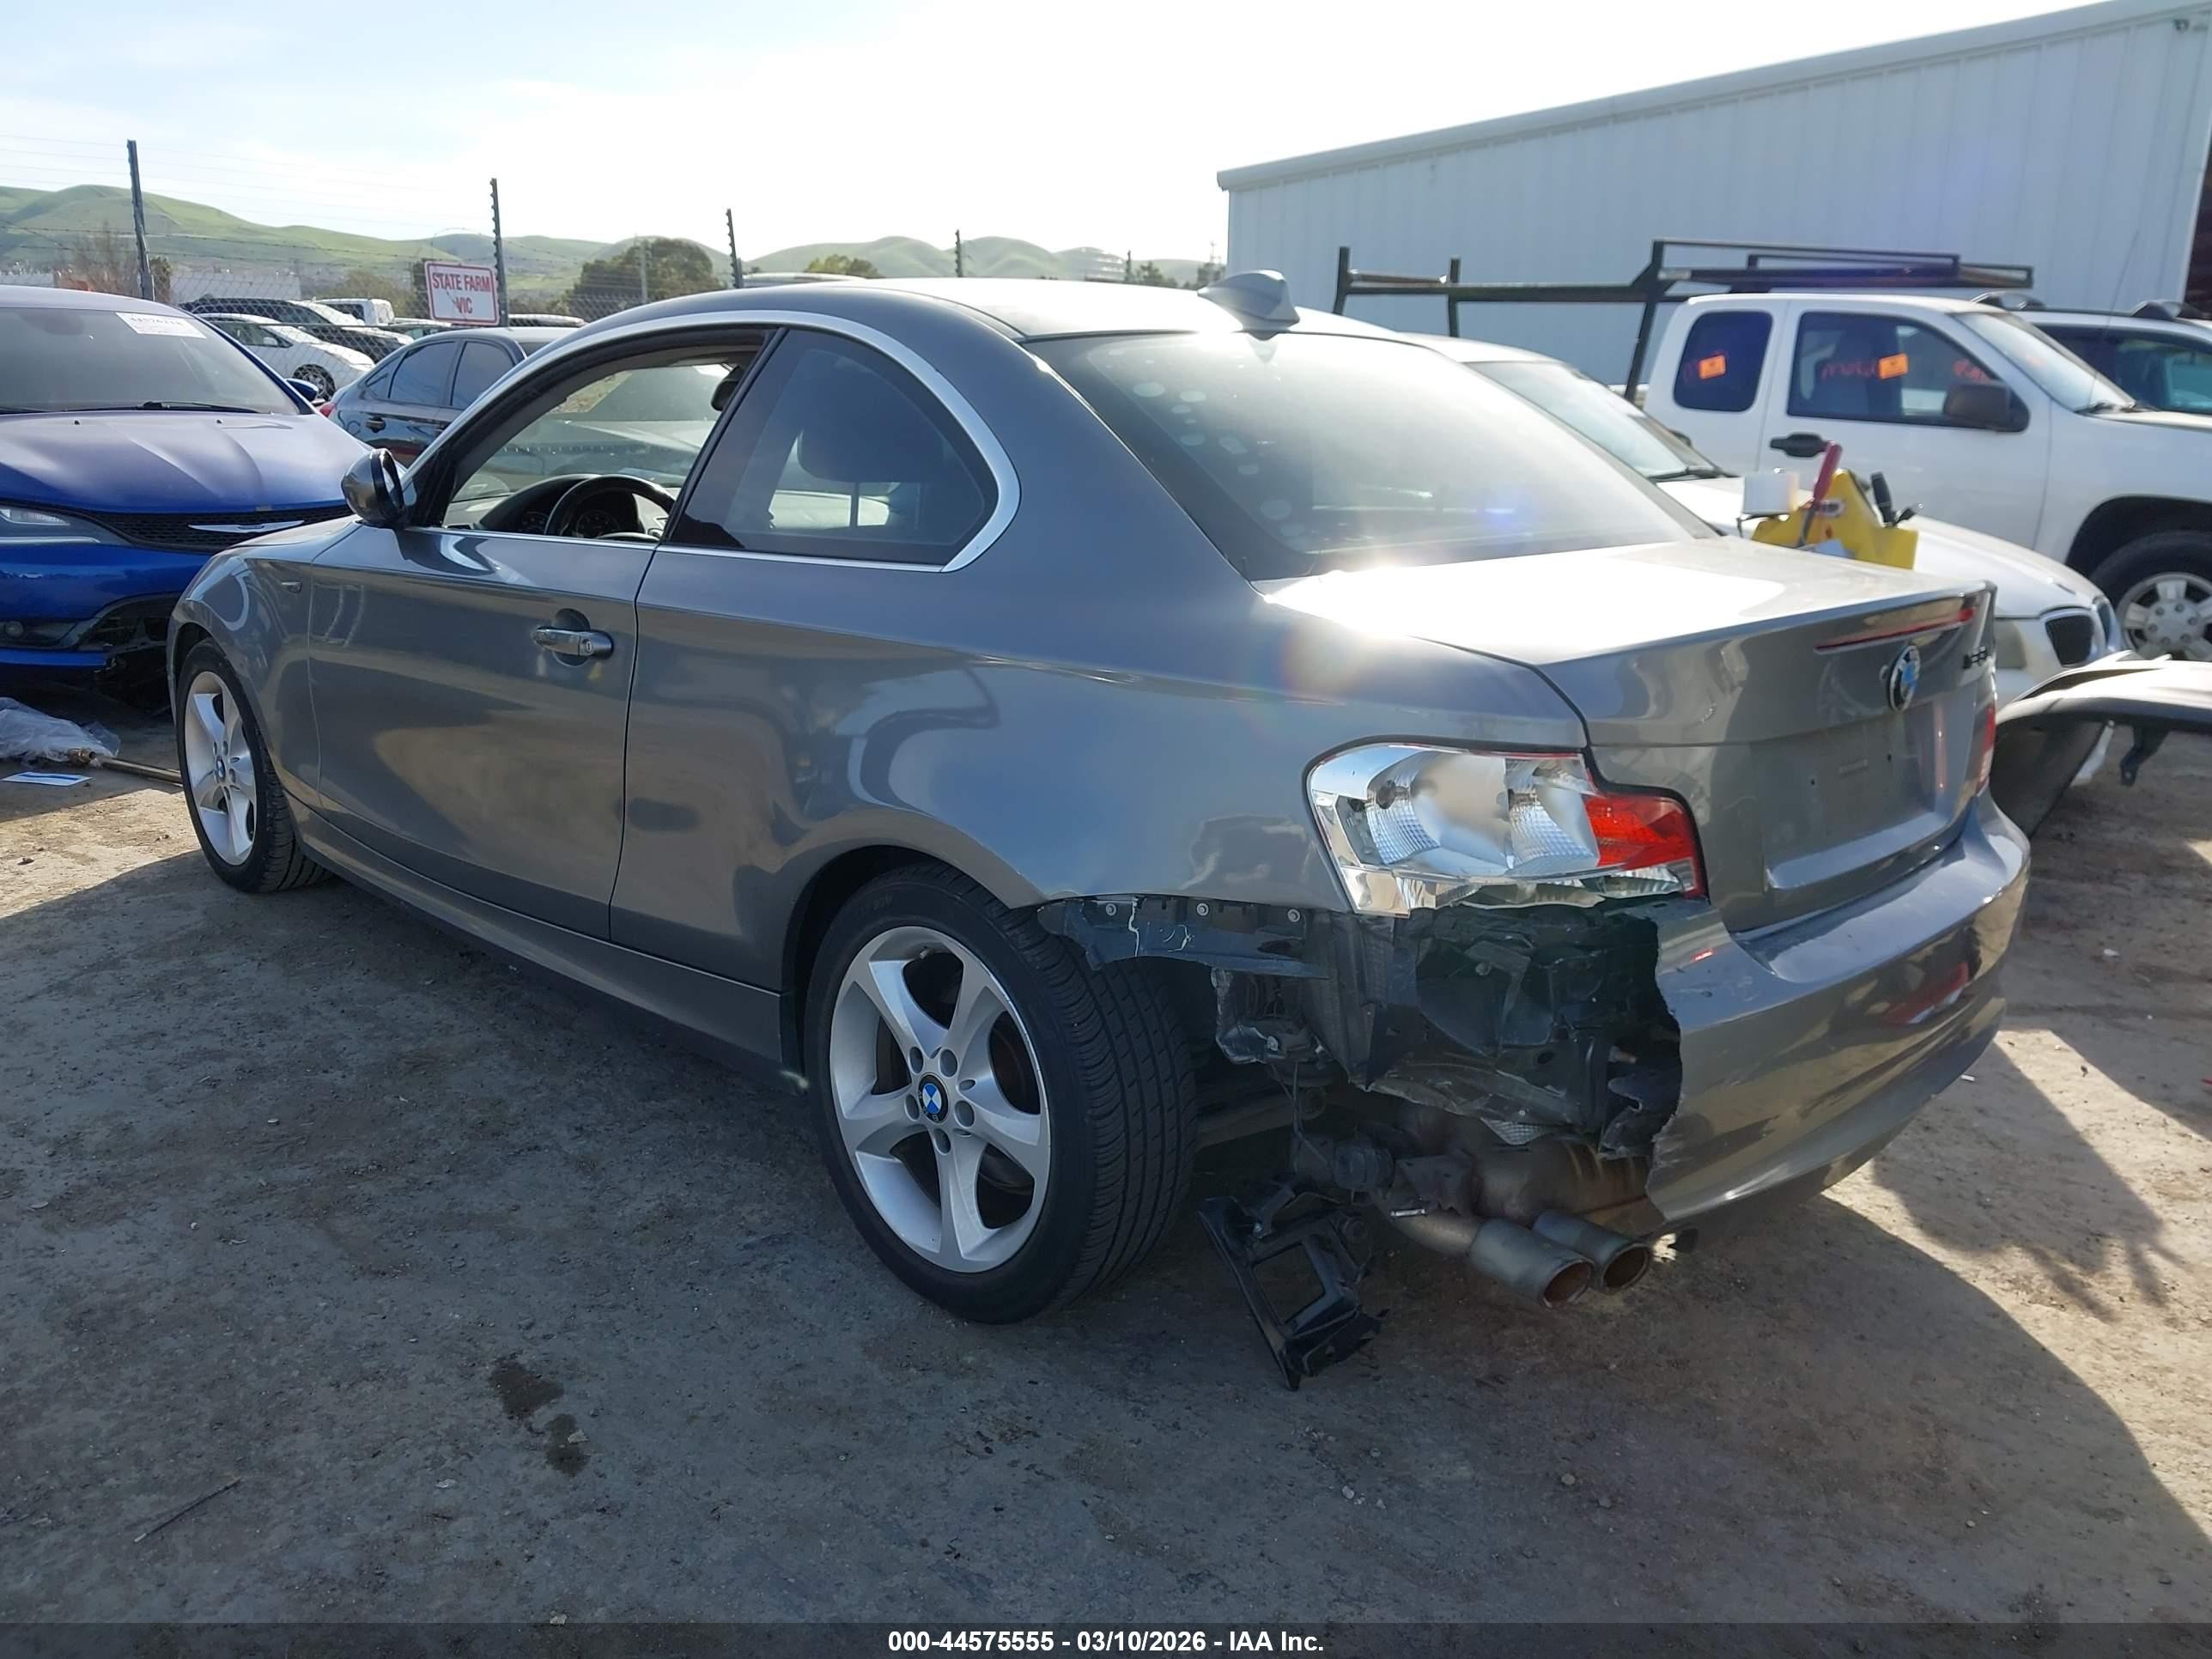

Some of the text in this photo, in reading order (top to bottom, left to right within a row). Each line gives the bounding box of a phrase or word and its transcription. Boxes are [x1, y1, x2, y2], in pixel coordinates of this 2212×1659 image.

[432, 272, 491, 292] STATE FARM
[455, 296, 473, 314] VIC
